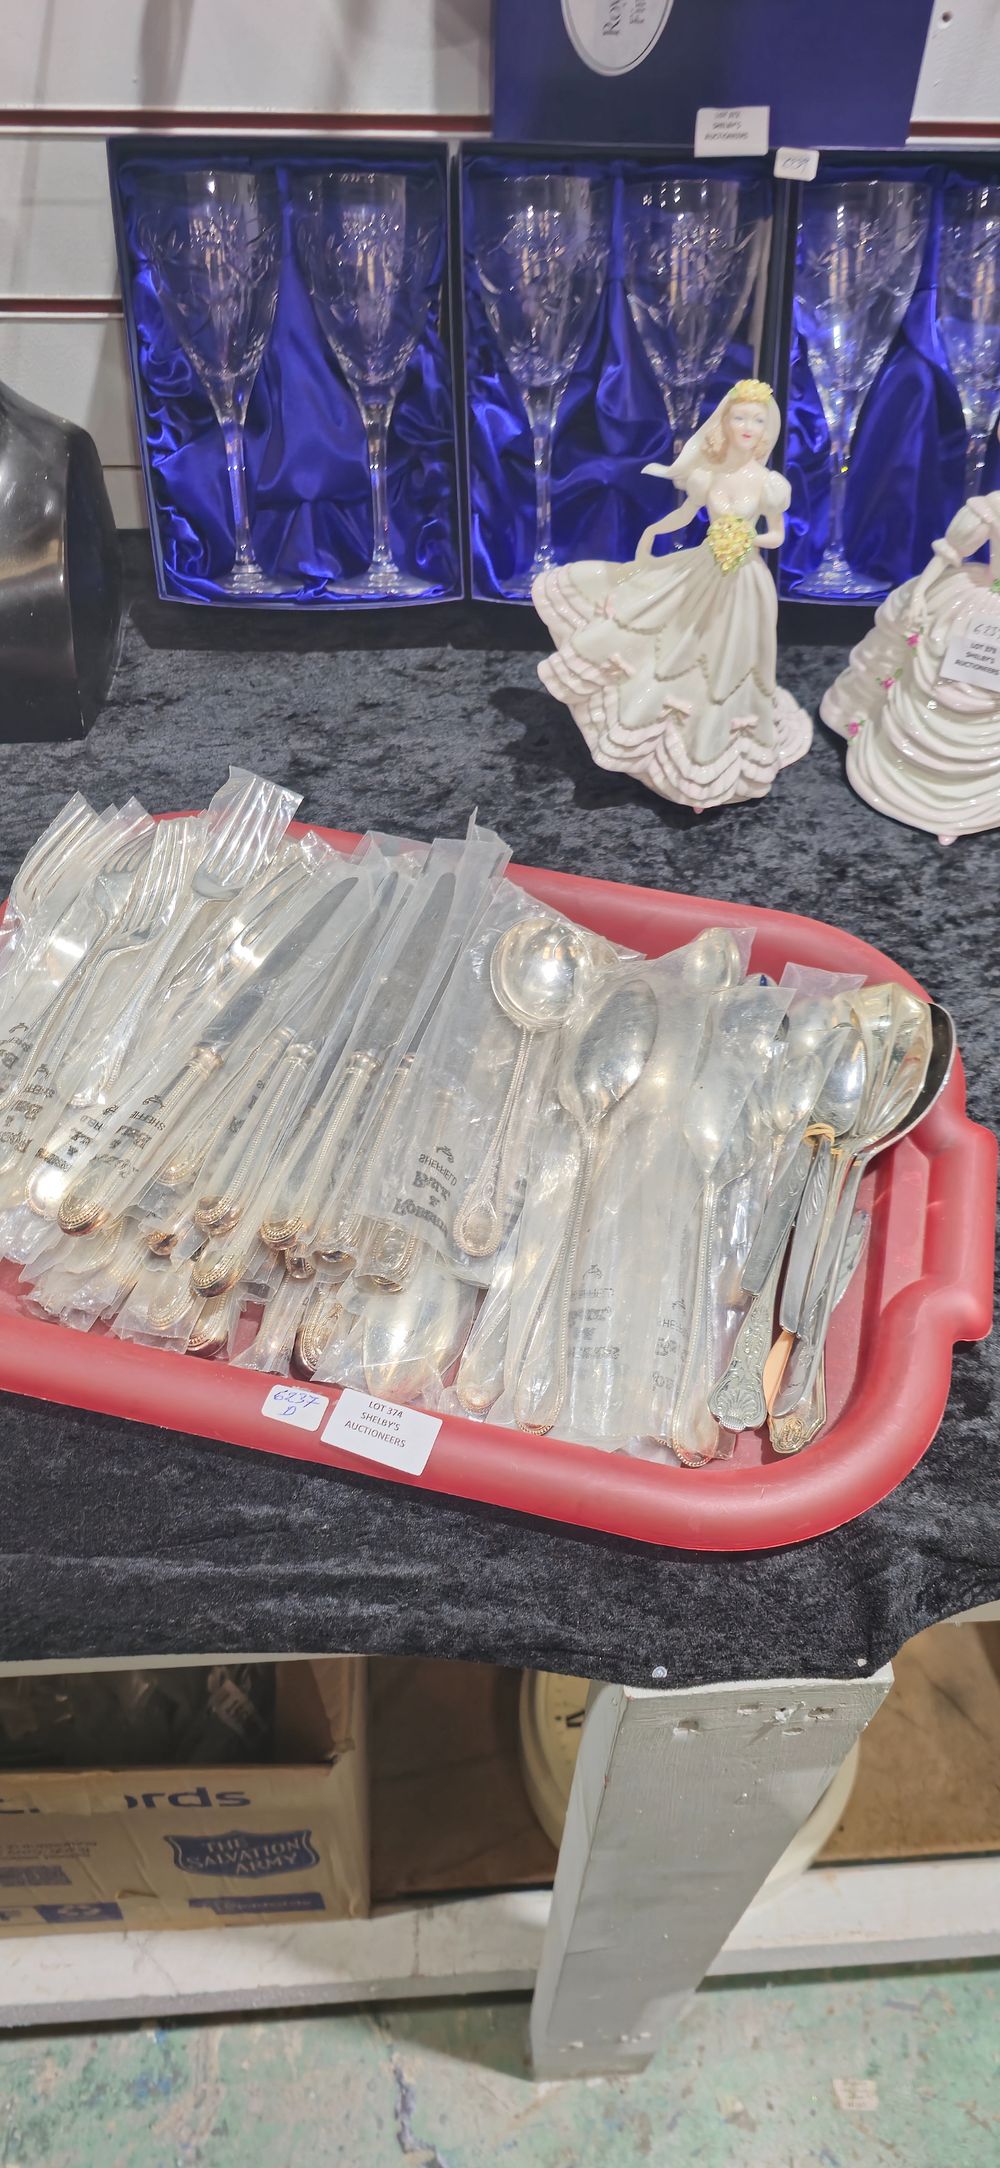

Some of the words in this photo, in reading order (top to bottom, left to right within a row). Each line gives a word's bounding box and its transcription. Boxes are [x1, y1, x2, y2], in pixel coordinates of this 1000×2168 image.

[272, 1389, 321, 1408] 6237
[368, 1400, 386, 1413] LOT
[387, 1406, 403, 1418] 374
[360, 1411, 400, 1431] SHELBY'S
[344, 1420, 407, 1448] AUCTIONEERS
[186, 1837, 301, 1870] SALVATION
[235, 1852, 297, 1875] ARMY
